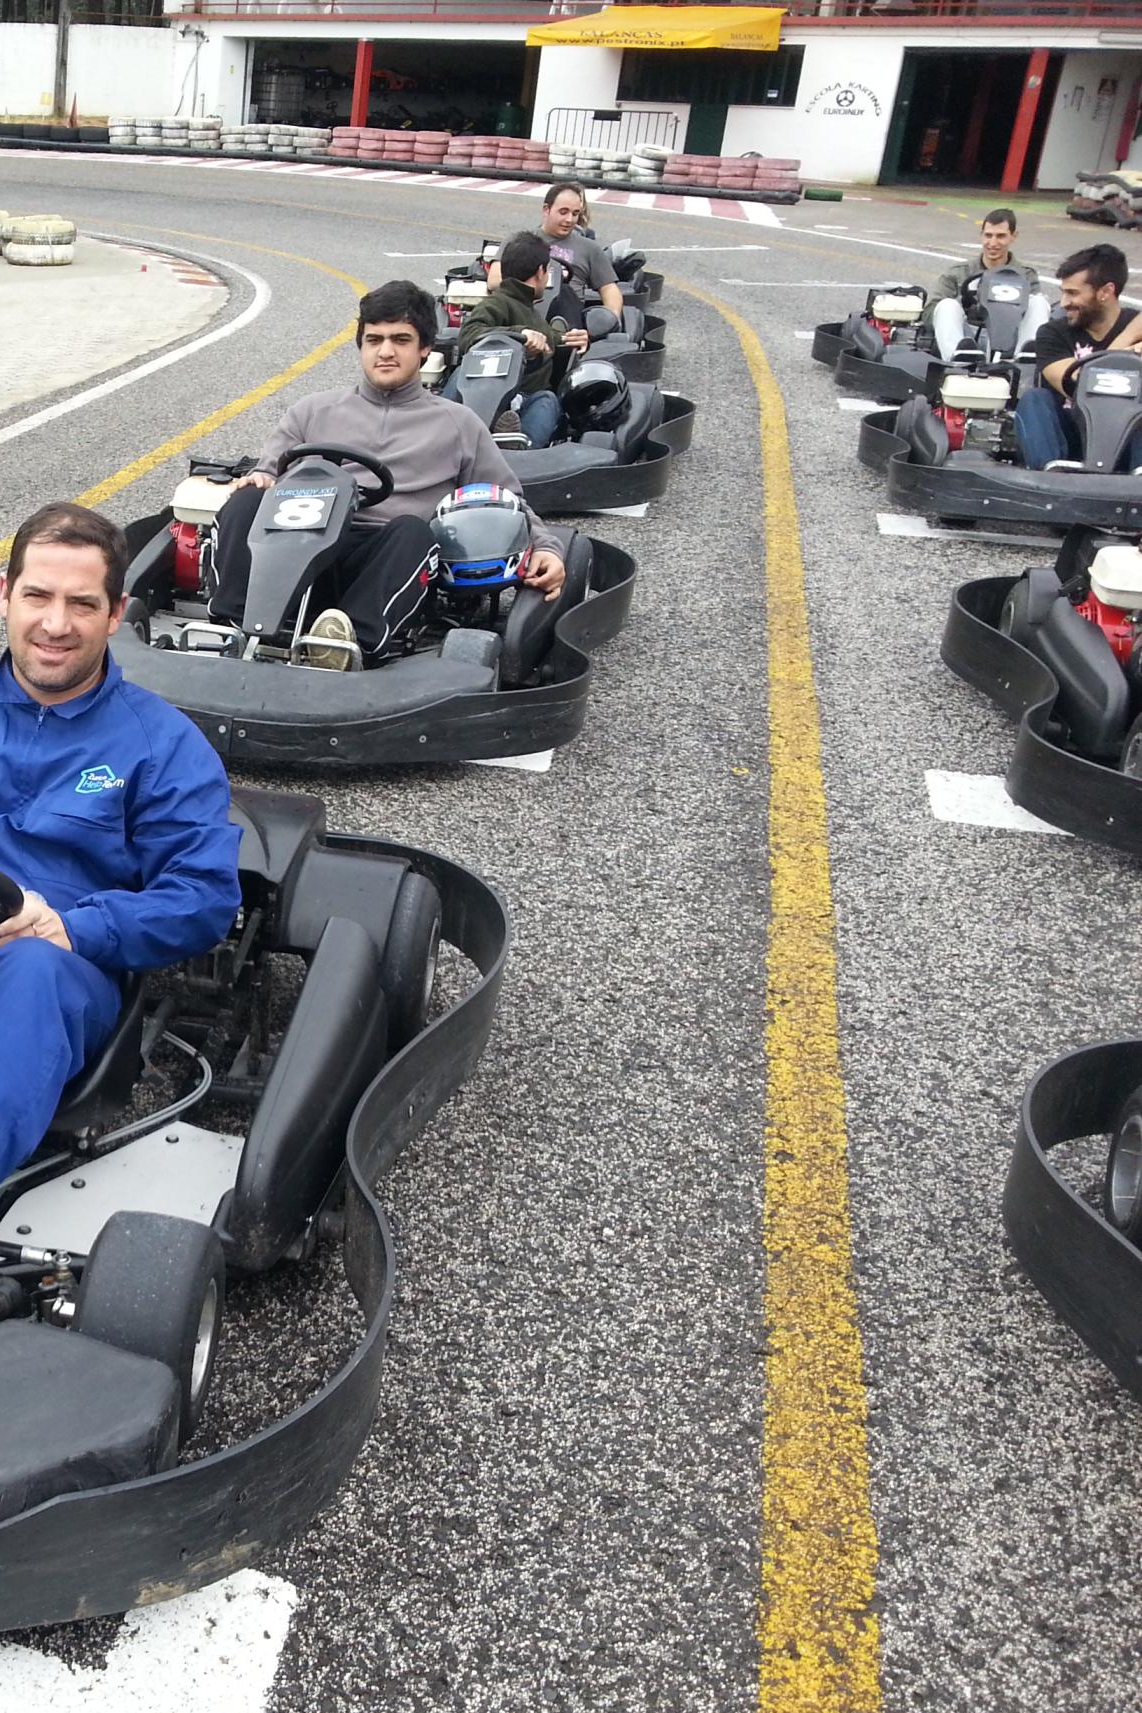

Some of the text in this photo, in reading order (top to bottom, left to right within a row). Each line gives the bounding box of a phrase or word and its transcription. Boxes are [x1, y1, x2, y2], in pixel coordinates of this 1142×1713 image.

[804, 81, 882, 117] ESCOLA KARTING
[822, 108, 866, 116] EUROINDY
[991, 284, 1021, 302] 9
[479, 357, 501, 376] 1
[1092, 373, 1132, 395] 3
[273, 498, 326, 527] 8
